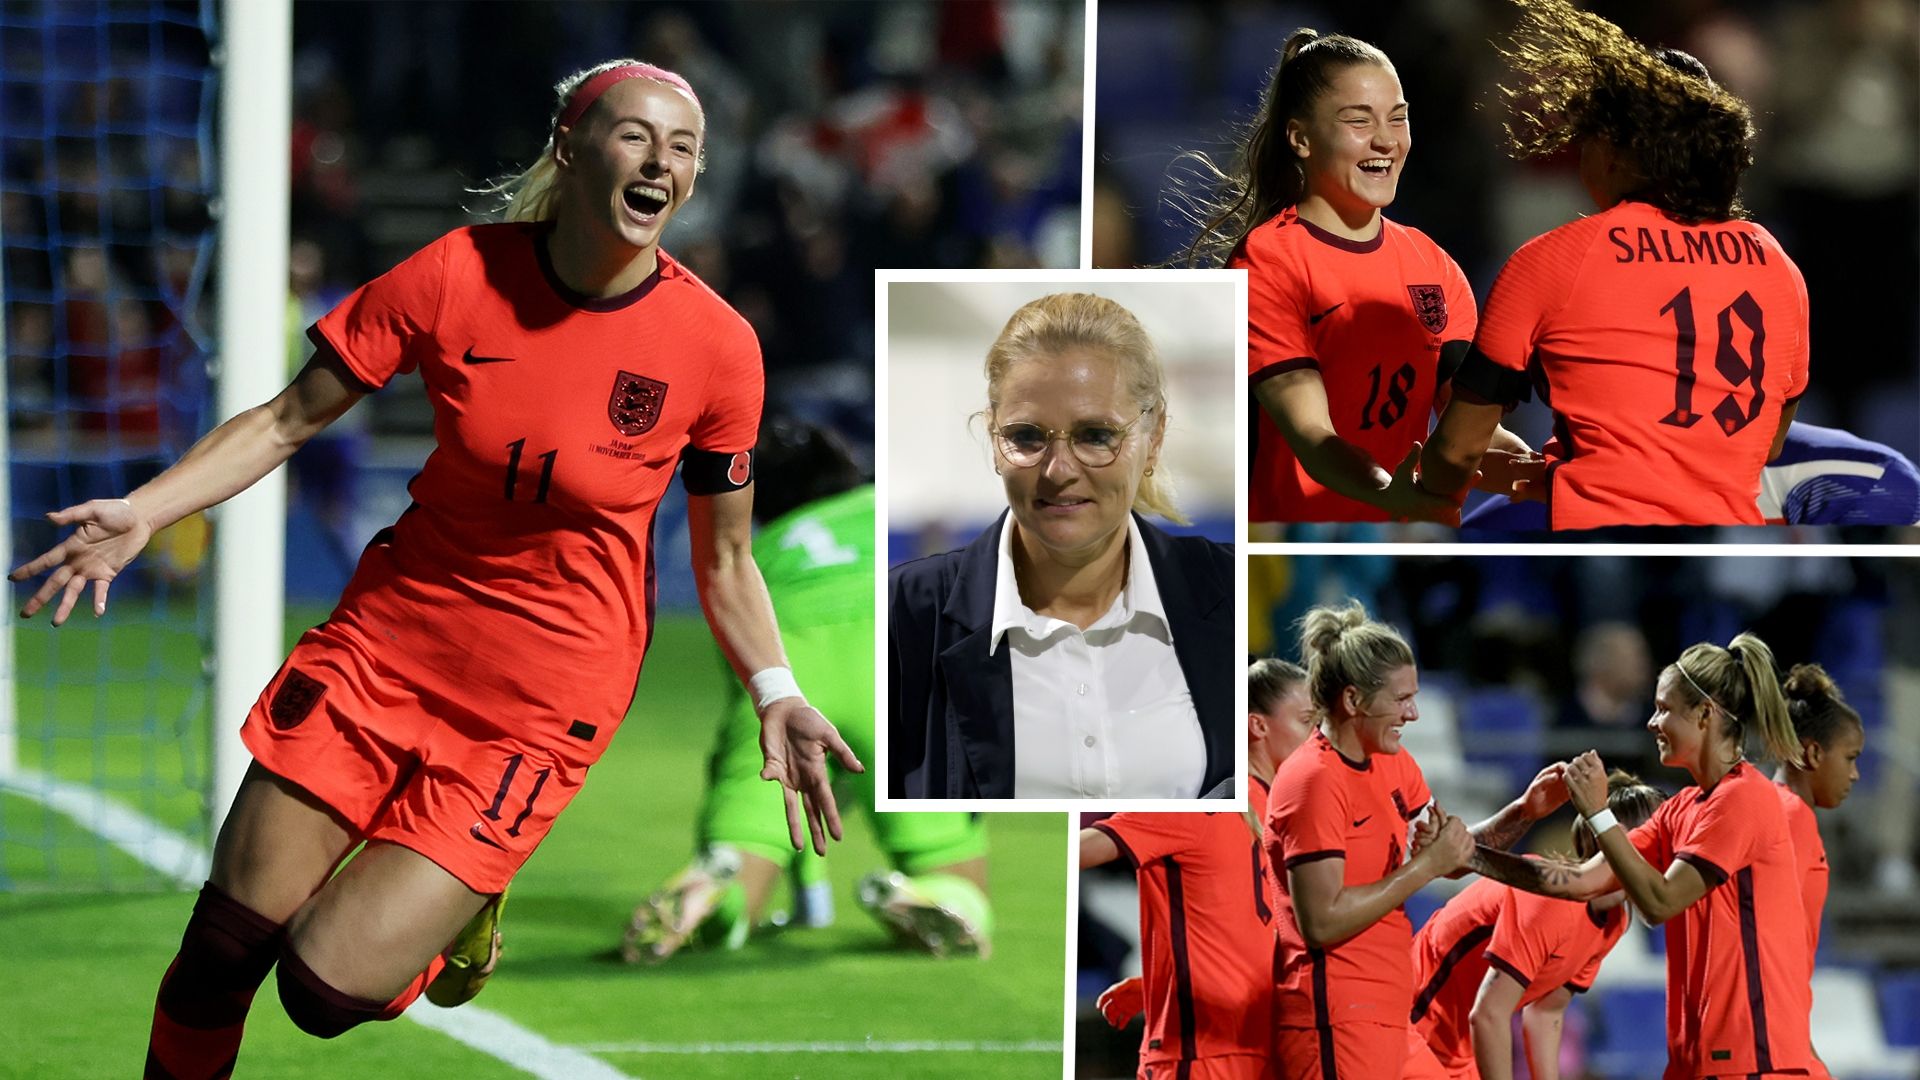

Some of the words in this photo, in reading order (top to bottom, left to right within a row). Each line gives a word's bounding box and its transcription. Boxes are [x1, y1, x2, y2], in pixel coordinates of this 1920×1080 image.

[1608, 227, 1767, 266] SALMON
[1658, 286, 1766, 437] 19
[1359, 362, 1416, 430] 18
[504, 436, 558, 504] 11
[609, 439, 634, 450] JAPAN
[779, 516, 858, 570] 1
[480, 753, 551, 838] 11
